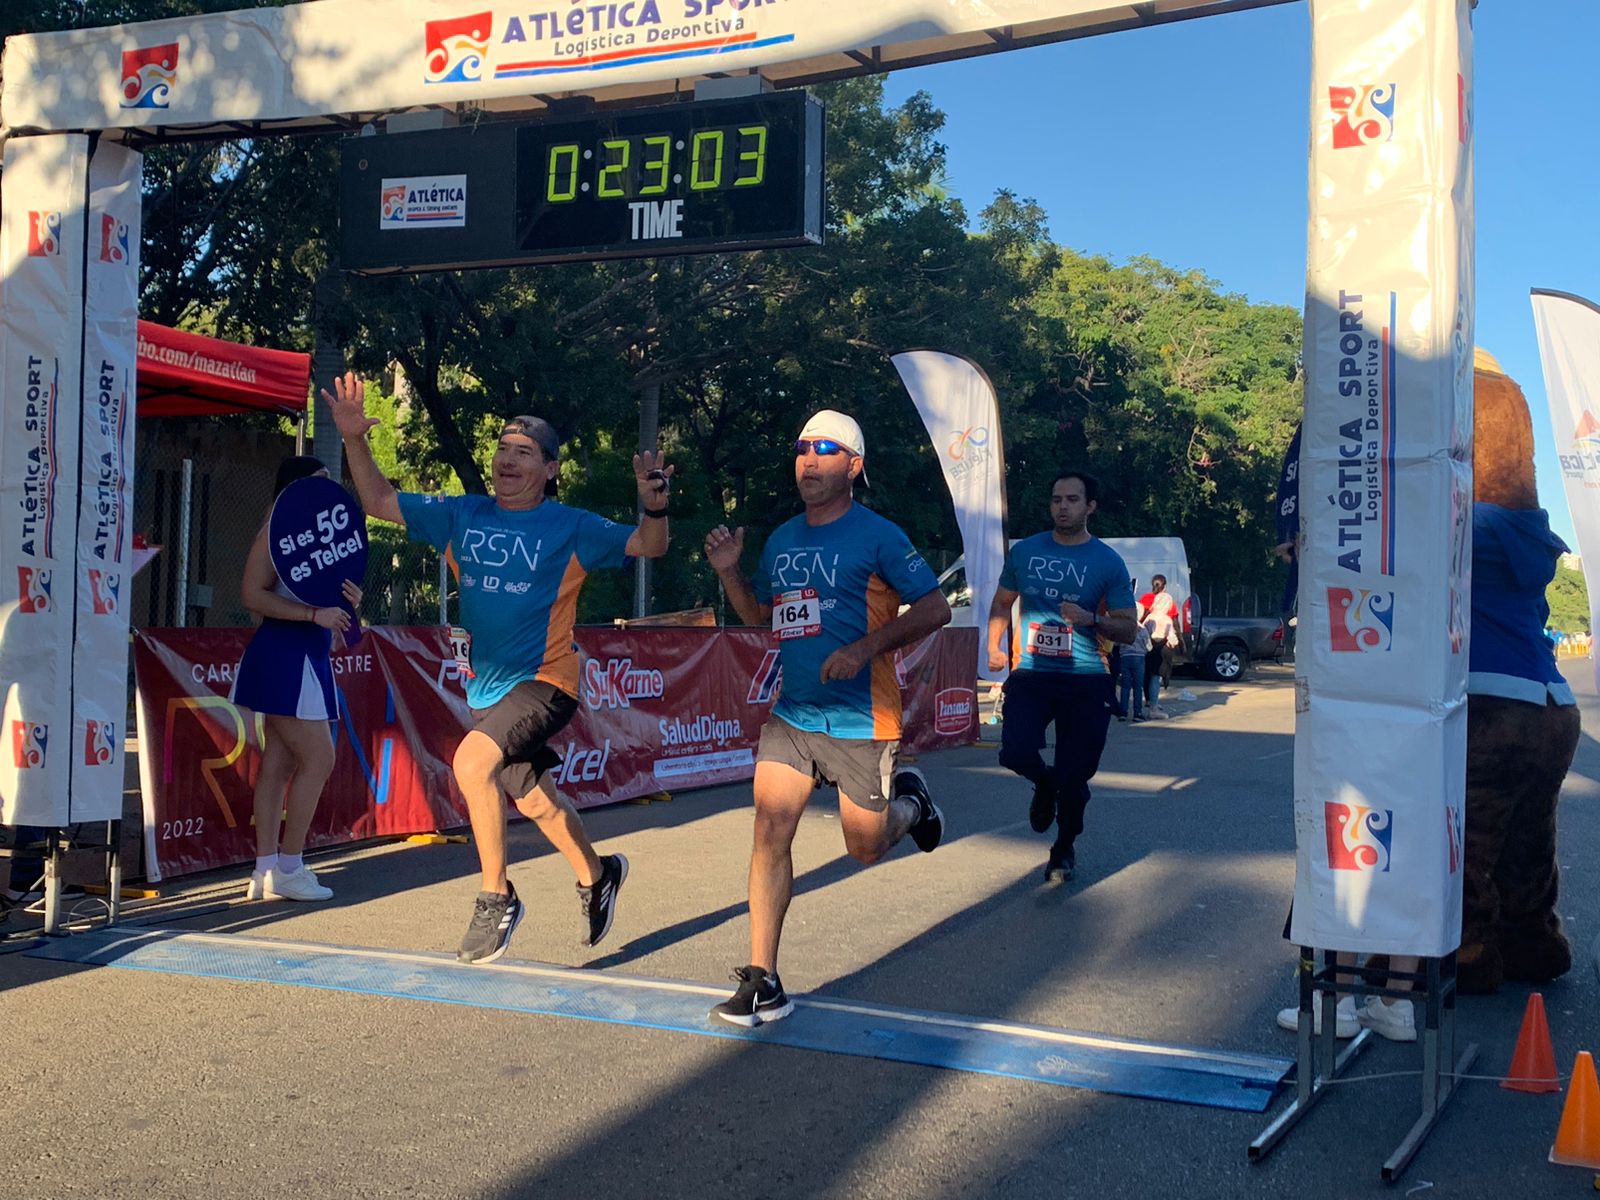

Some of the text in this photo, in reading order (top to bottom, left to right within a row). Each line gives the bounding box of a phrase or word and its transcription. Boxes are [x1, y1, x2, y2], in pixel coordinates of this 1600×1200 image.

[646, 17, 745, 43] Deportiva
[628, 199, 685, 240] TIME
[1338, 289, 1363, 398] SPORT
[25, 355, 42, 432] SPORT
[98, 360, 115, 436] SPORT
[1364, 338, 1382, 522] Logística Deportiva
[279, 503, 350, 555] Si es 5G
[461, 528, 542, 572] RSN
[290, 530, 364, 583] es Telcel
[771, 552, 840, 588] RSN
[1027, 556, 1088, 588] RSN
[778, 603, 810, 625] 164
[1037, 633, 1062, 647] 031
[586, 657, 665, 711] SuKarne
[659, 714, 741, 747] SaludDigna
[162, 817, 204, 840] 2022
